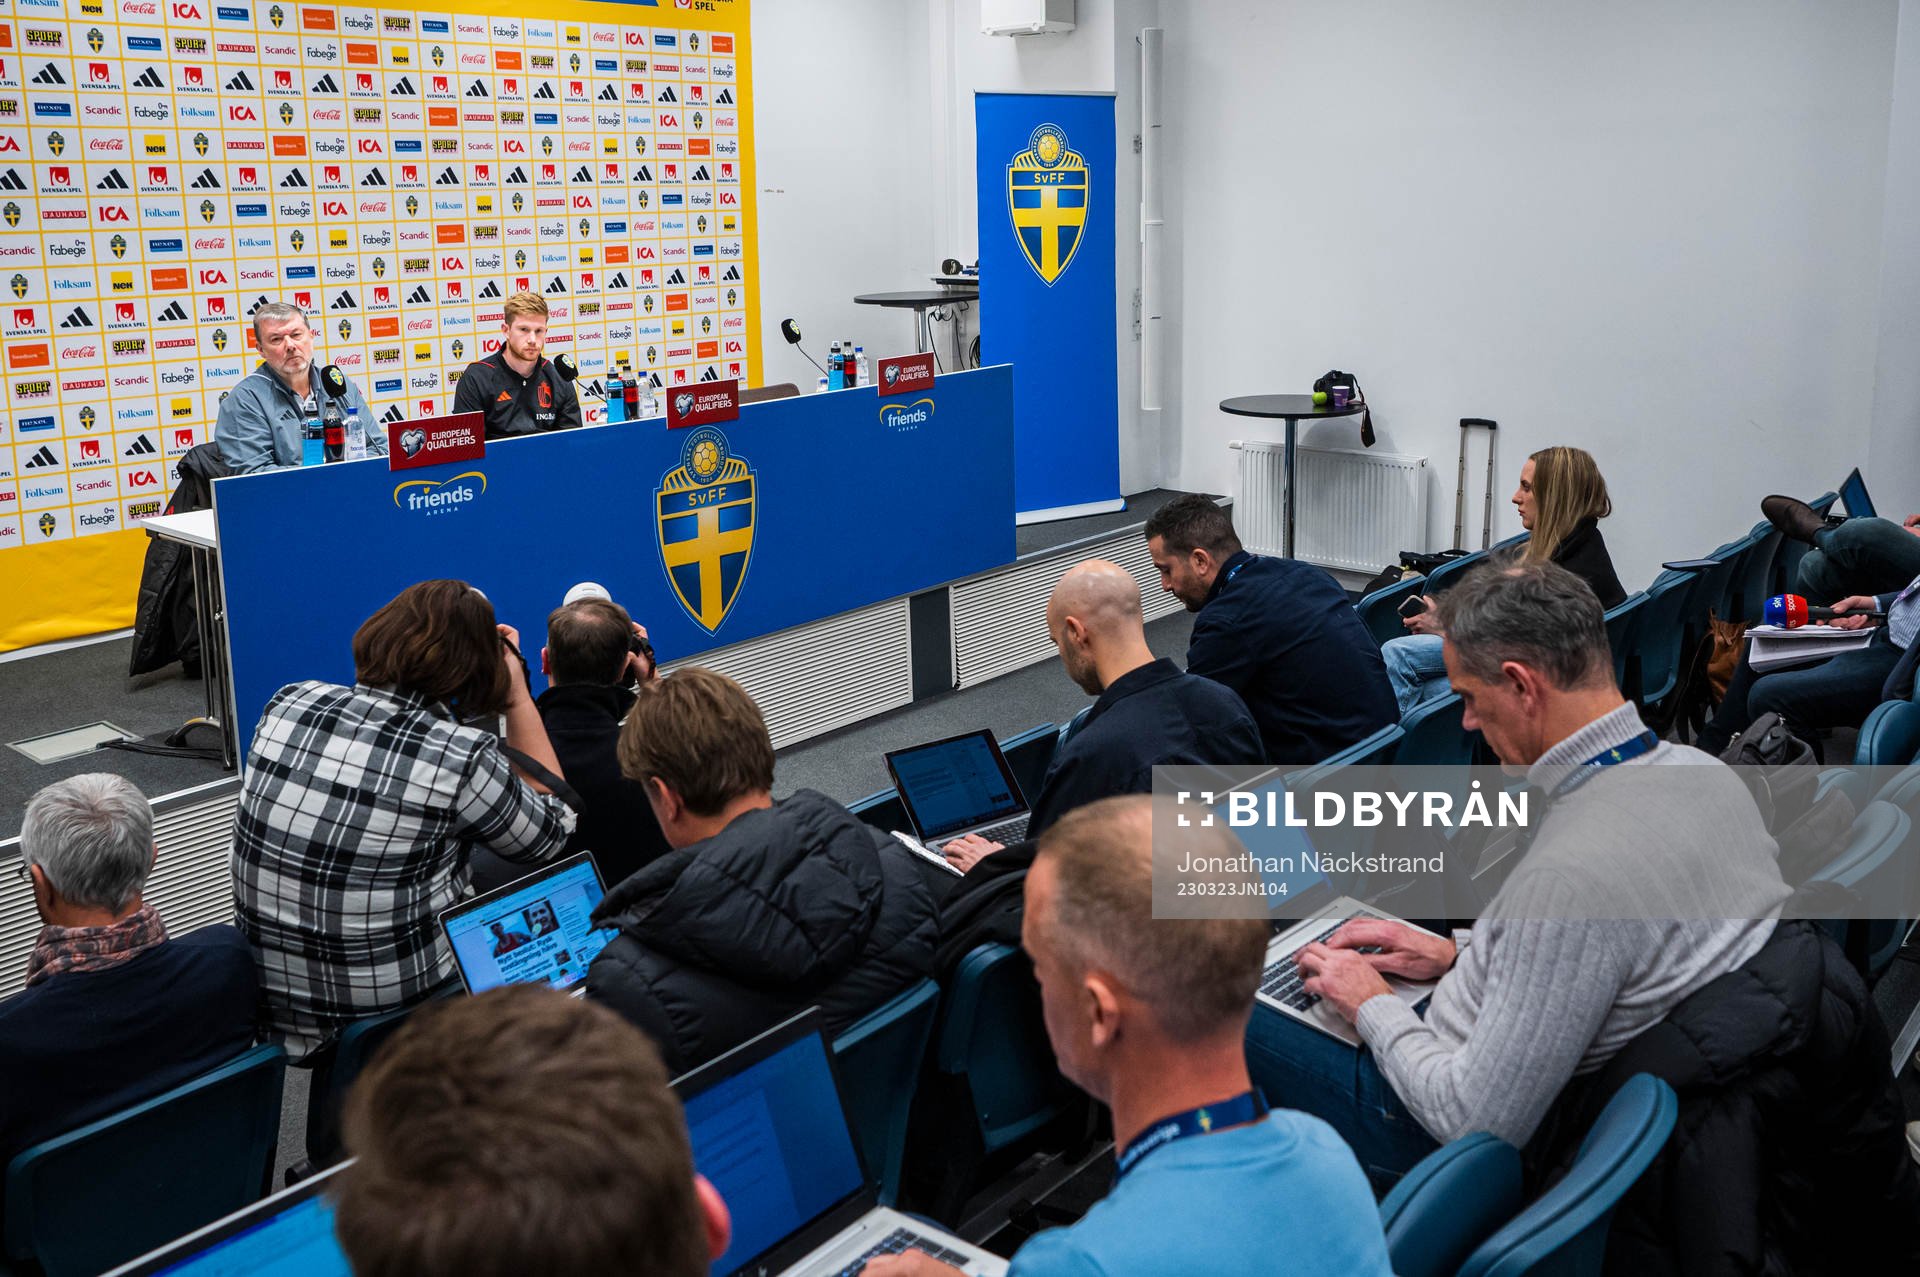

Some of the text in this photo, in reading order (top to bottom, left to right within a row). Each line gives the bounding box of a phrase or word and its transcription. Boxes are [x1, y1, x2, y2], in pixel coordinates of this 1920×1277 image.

[173, 3, 201, 19] ICA
[695, 2, 715, 11] SPEL
[345, 17, 373, 30] Fabege
[26, 29, 61, 43] SPORT
[626, 33, 643, 45] ICA
[265, 46, 294, 55] Scandic
[307, 47, 336, 60] Fabege
[85, 106, 120, 114] Scandic
[135, 106, 168, 120] Fabege
[180, 107, 215, 118] Folksam
[229, 106, 256, 120] ICA
[660, 115, 677, 127] ICA
[316, 142, 344, 154] Fabege
[358, 139, 382, 153] ICA
[504, 140, 524, 152] ICA
[1034, 173, 1065, 183] SvFF
[573, 196, 592, 208] ICA
[720, 193, 735, 204] ICA
[43, 211, 85, 219] BAUHAUS
[99, 206, 128, 222] ICA
[144, 208, 180, 218] Folksam
[281, 206, 310, 217] Fabege
[323, 202, 347, 216] ICA
[363, 235, 390, 246] Fabege
[50, 245, 86, 257] Fabege
[637, 247, 654, 259] ICA
[442, 257, 464, 270] ICA
[200, 269, 227, 284] ICA
[240, 270, 273, 280] Scandic
[327, 268, 355, 278] Fabege
[53, 280, 91, 289] Folksam
[482, 340, 502, 352] ICA
[726, 341, 741, 352] ICA
[206, 368, 240, 377] Folksam
[903, 365, 926, 373] EUROPEAN
[115, 376, 148, 386] Scandic
[162, 373, 194, 384] Fabege
[900, 371, 929, 382] QUALIFIERS
[16, 382, 50, 394] SPORT
[63, 381, 107, 389] BAUHAUS
[699, 393, 728, 405] EUROPEAN
[695, 400, 732, 412] QUALIFIERS
[117, 409, 154, 418] Folksam
[888, 409, 926, 427] friends
[432, 428, 470, 440] EUROPEAN
[427, 436, 476, 451] QUALIFIERS
[128, 471, 157, 487] ICA
[76, 480, 111, 491] Scandic
[25, 488, 64, 499] Folksam
[408, 486, 473, 510] friends
[688, 487, 727, 506] SvFF
[426, 507, 458, 516] ARENA
[80, 514, 114, 526] Fabege
